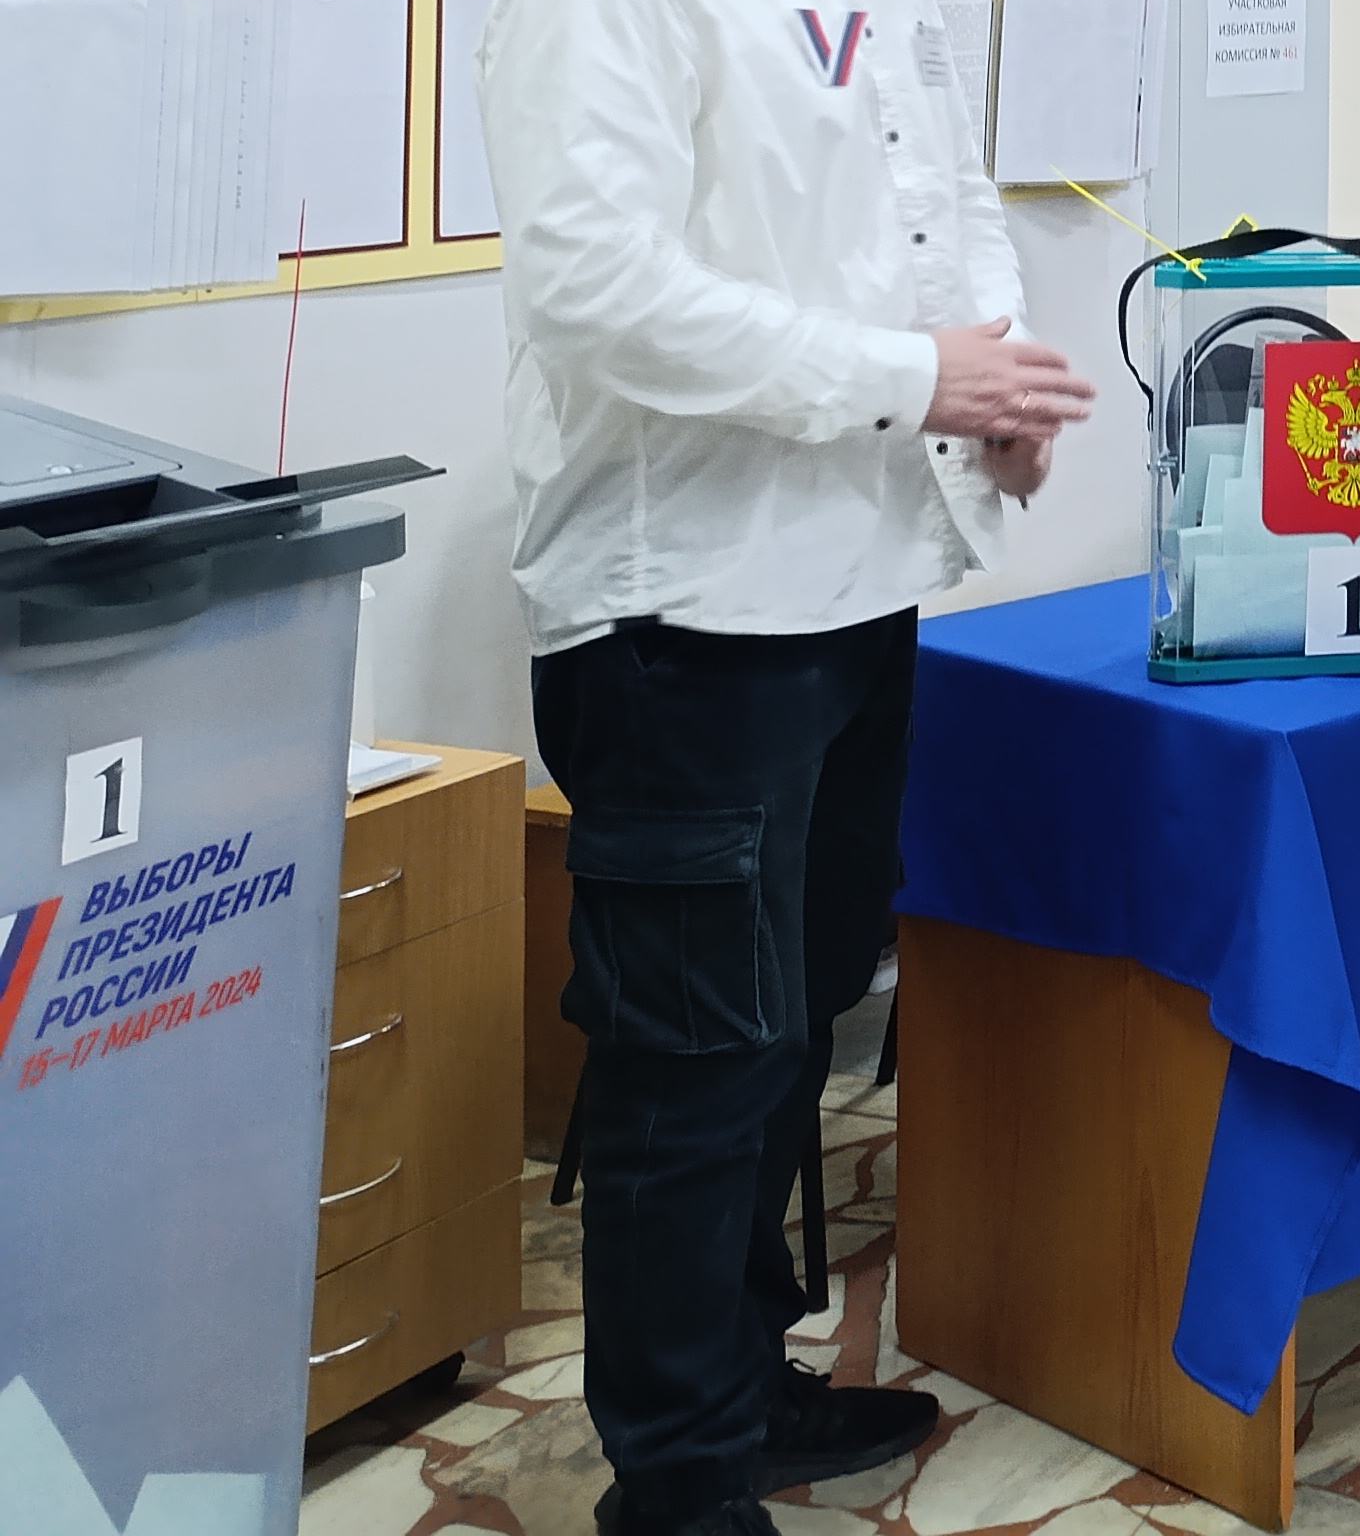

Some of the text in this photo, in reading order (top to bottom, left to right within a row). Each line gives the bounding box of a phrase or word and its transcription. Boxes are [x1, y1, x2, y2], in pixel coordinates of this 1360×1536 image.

[1215, 46, 1298, 63] КОМИССИЯ № 461
[1218, 21, 1296, 37] ИЗБИРАТЕЛЬНАЯ
[89, 756, 128, 843] 1
[57, 862, 296, 983] ПРЕЗИДЕНТА
[79, 830, 252, 924] ВЫБОРЫ
[34, 945, 198, 1041] РОССИИ
[100, 991, 196, 1058] МАРТА
[198, 964, 263, 1020] 2024
